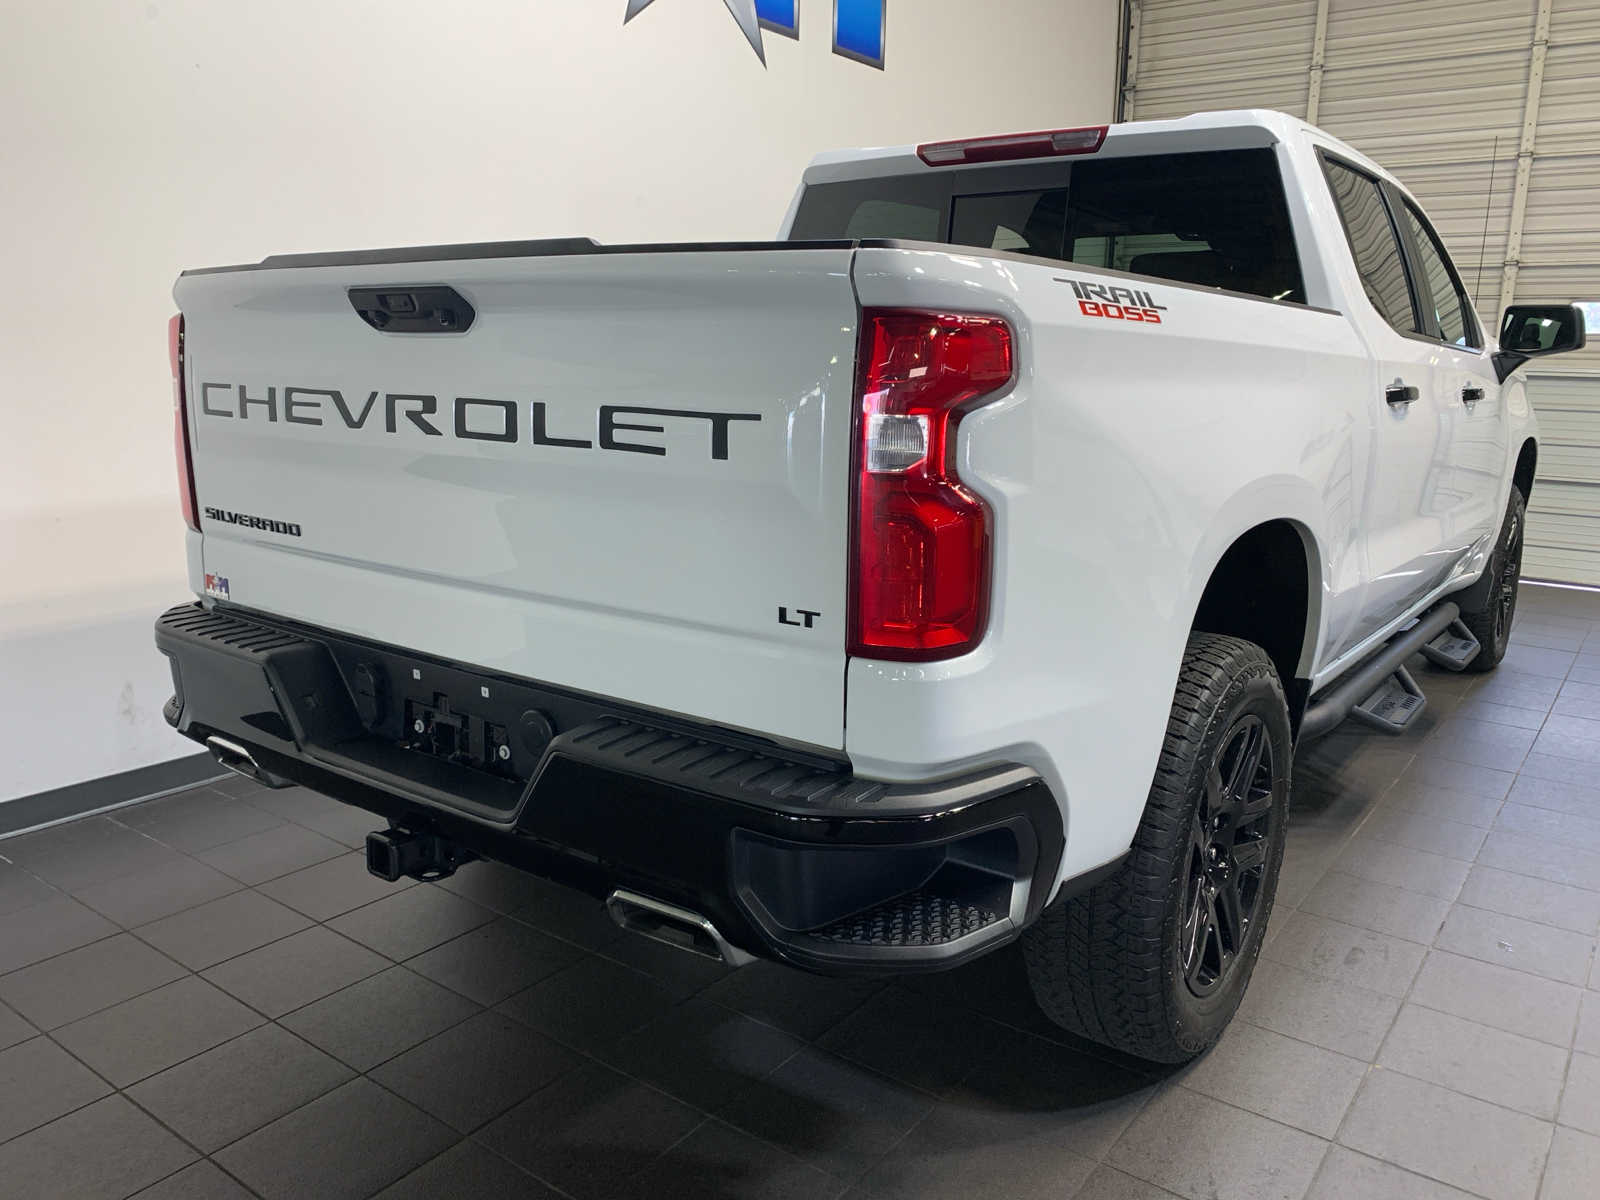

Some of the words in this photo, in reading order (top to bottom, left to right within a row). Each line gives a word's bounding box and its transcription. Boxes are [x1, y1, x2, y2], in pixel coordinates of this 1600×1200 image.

[1053, 277, 1167, 310] TRAIL
[1078, 300, 1162, 323] BOSS
[202, 382, 762, 460] CHEVROLET
[204, 506, 302, 537] SILVERADO
[778, 606, 821, 628] LT
